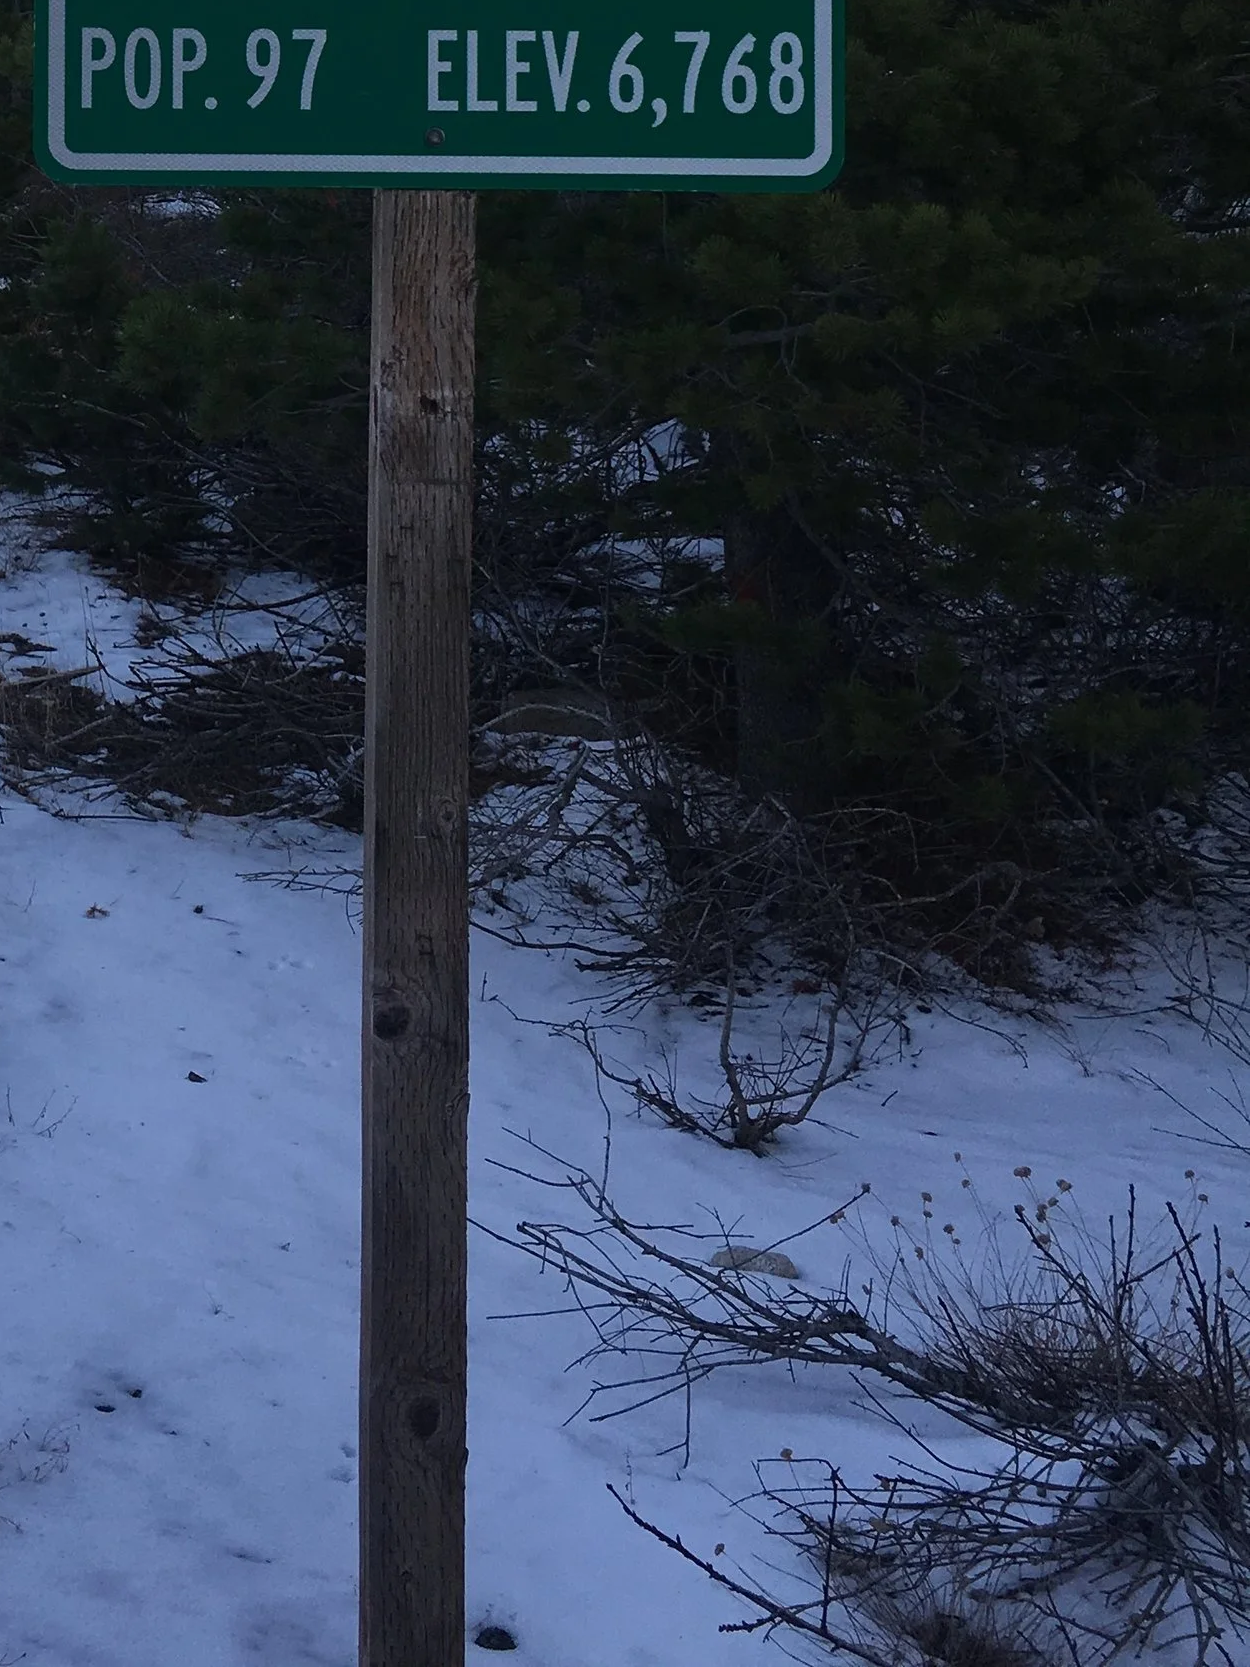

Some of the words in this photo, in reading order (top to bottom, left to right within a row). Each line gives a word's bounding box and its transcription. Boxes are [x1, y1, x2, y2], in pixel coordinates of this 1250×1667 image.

[80, 27, 219, 110] POP.
[246, 28, 328, 111] 97
[427, 29, 591, 113] ELEV.
[608, 31, 806, 127] 6,768
